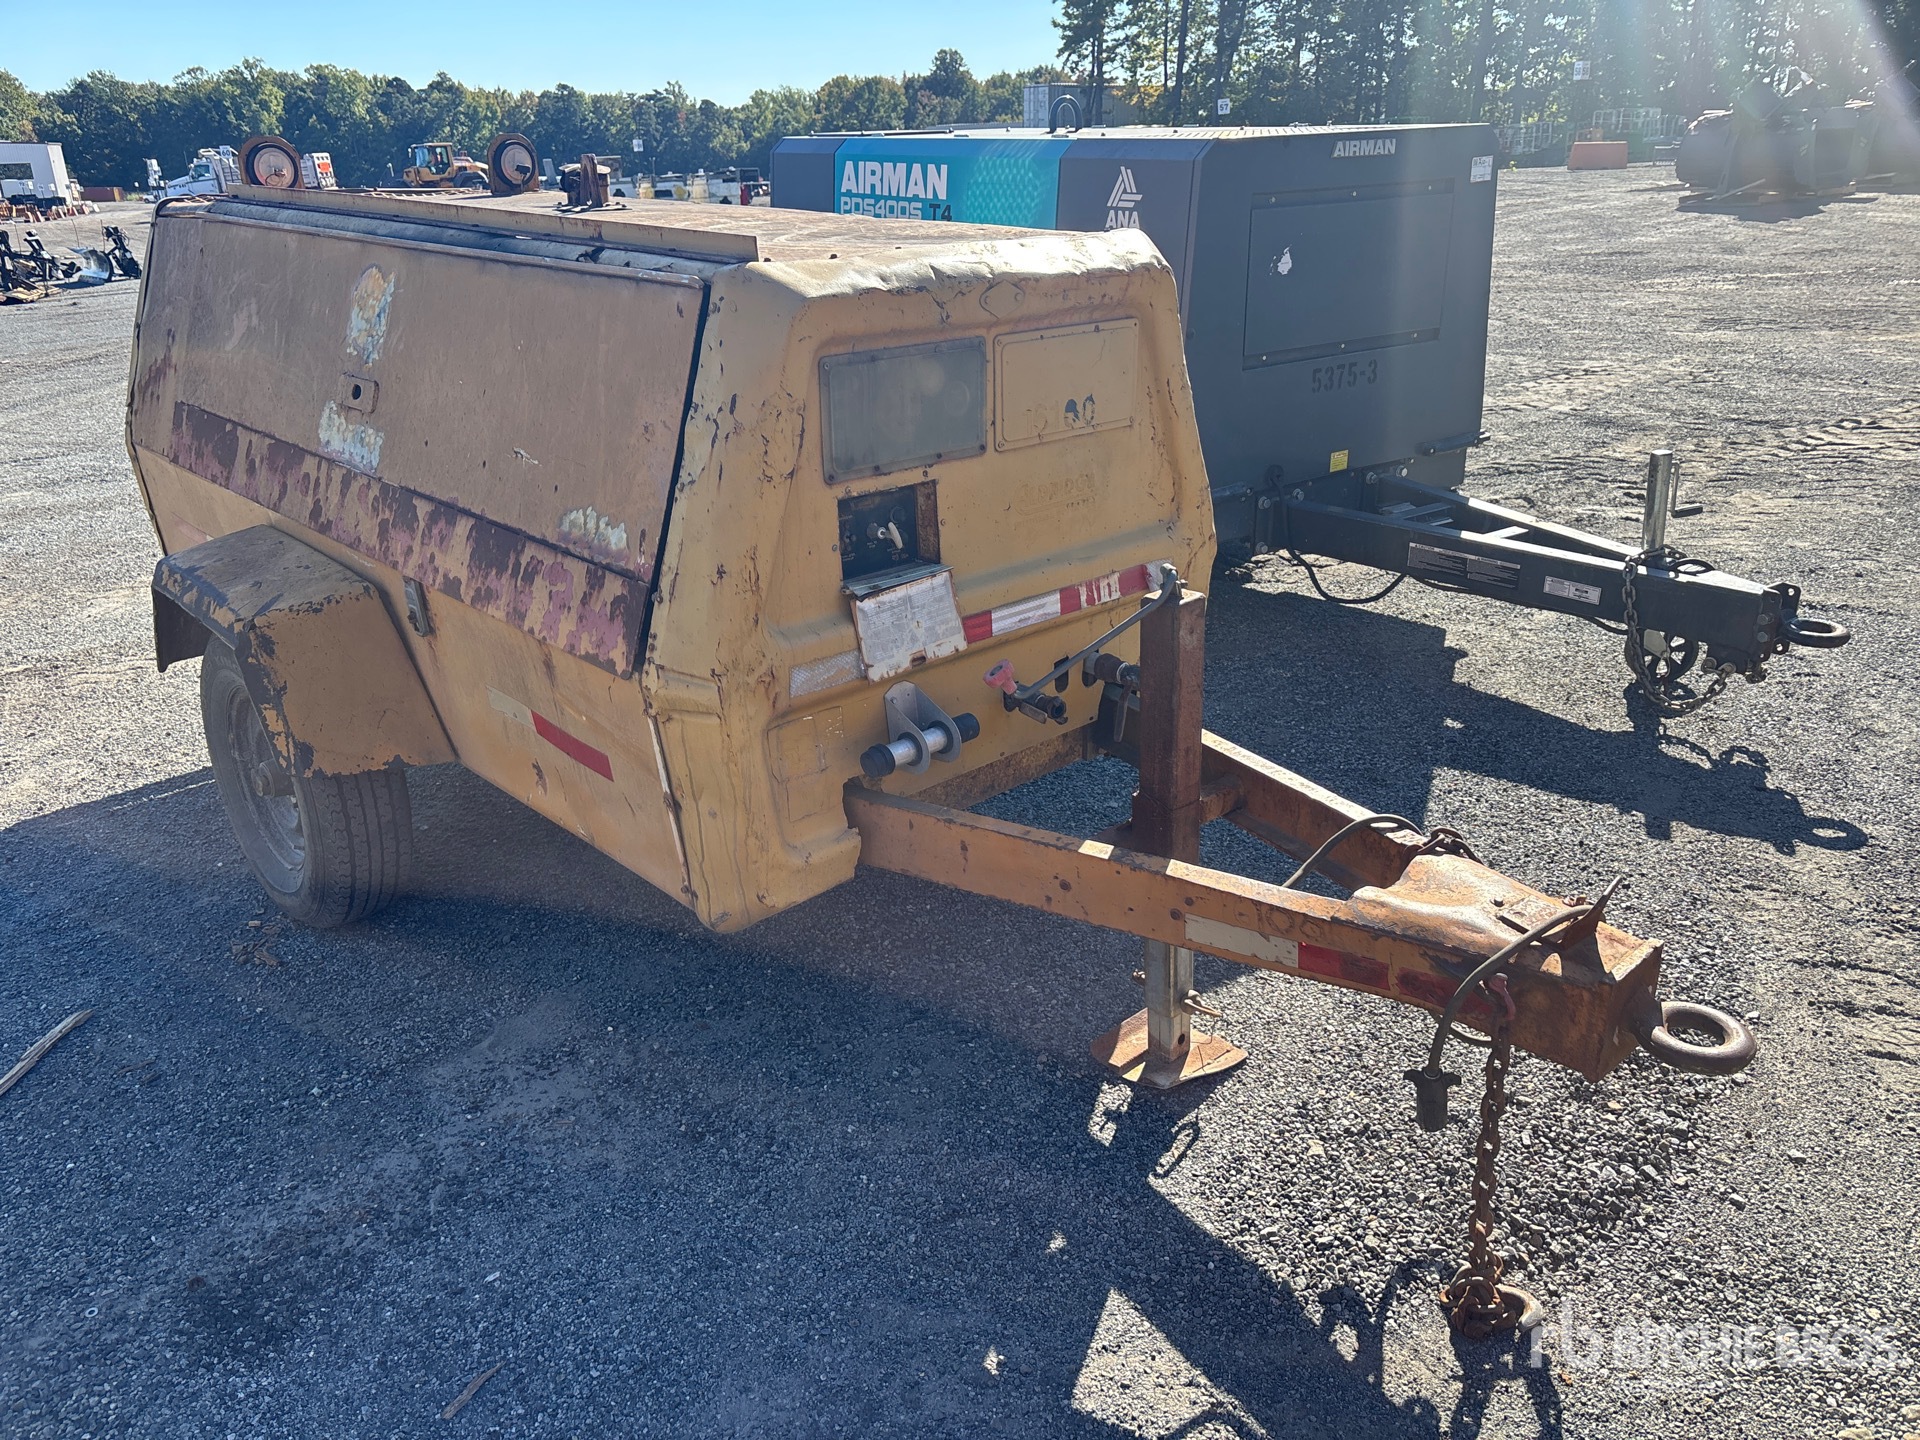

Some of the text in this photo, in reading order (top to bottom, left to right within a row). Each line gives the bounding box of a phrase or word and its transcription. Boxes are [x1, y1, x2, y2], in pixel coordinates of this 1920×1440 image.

[1219, 103, 1229, 111] 57
[1332, 138, 1397, 158] AIRMAN
[840, 160, 948, 200] AIRMAN
[840, 197, 953, 222] PDS400S T4
[1104, 209, 1141, 230] ANA
[1311, 358, 1379, 394] 5375-3
